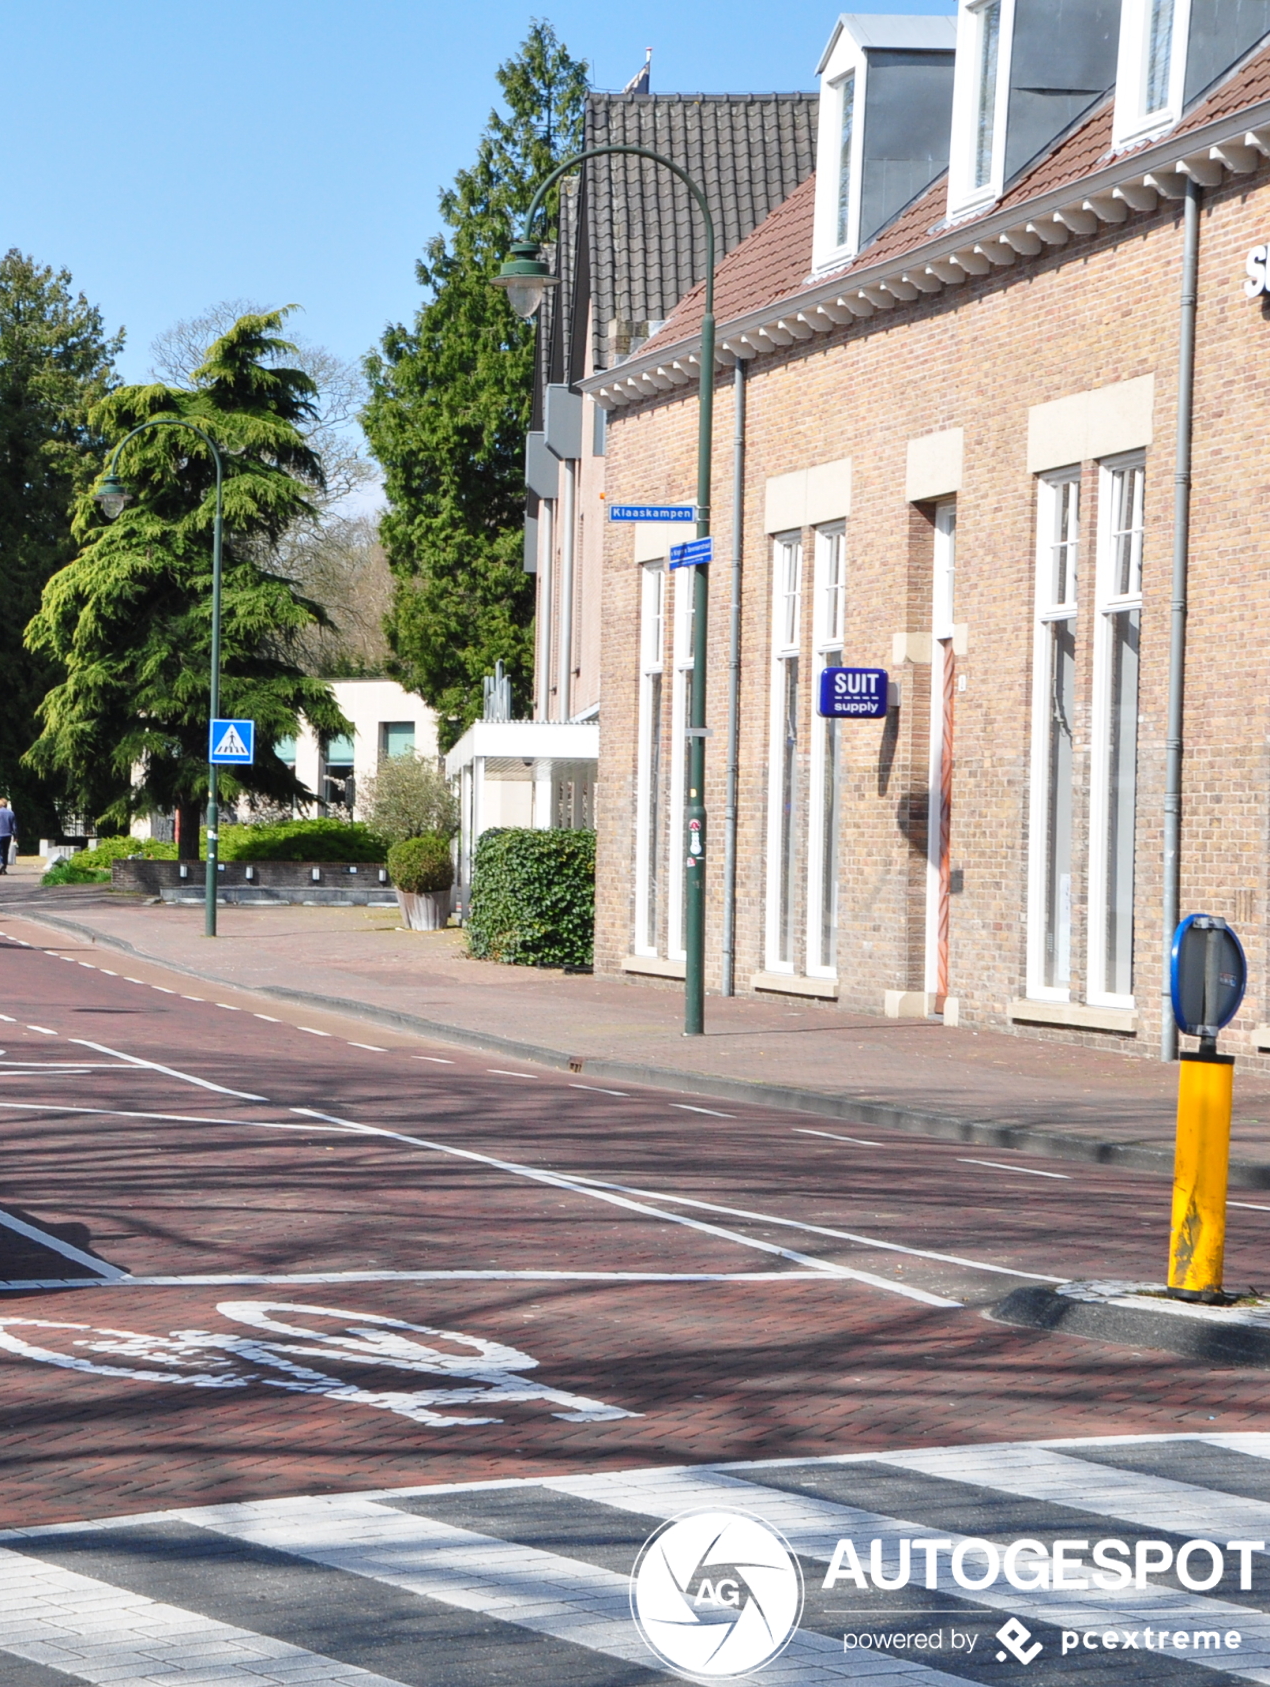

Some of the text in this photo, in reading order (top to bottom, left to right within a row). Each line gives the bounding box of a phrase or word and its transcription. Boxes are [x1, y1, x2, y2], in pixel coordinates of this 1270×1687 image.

[1244, 243, 1270, 298] S
[613, 507, 691, 519] Klaaskampen
[834, 672, 879, 694] SUIT
[834, 701, 879, 714] supply
